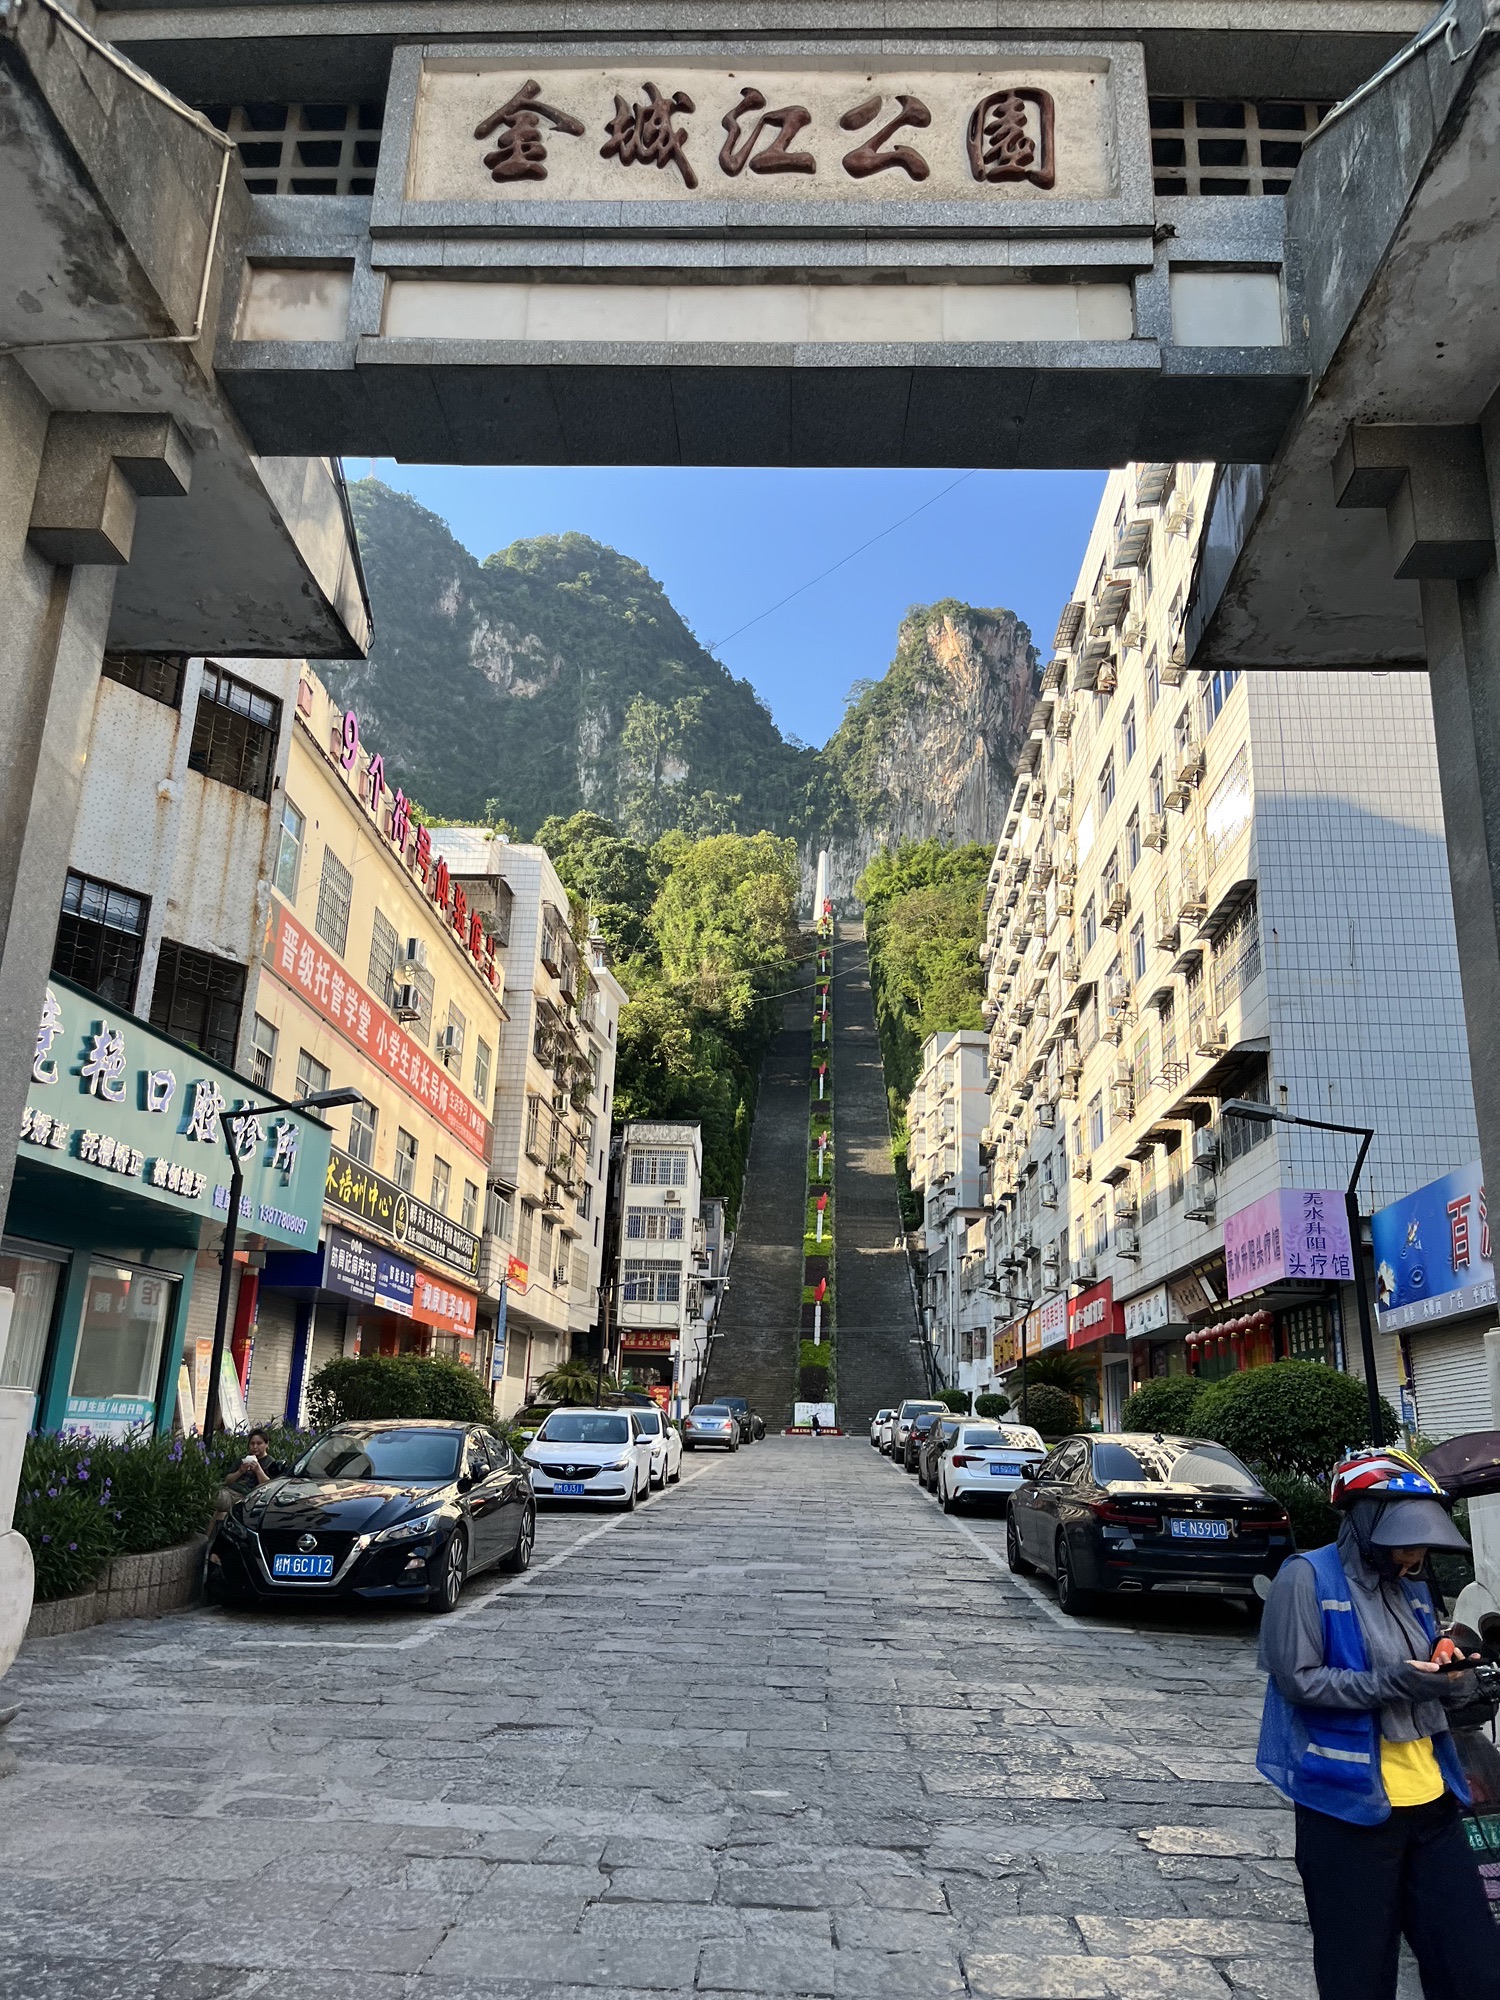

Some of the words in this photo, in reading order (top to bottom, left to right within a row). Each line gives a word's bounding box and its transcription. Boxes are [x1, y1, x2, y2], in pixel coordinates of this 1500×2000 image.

[281, 922, 372, 1044] 晋级托管学堂
[375, 1020, 449, 1116] 小学生成长导师
[1303, 1192, 1326, 1251] 无水升阳
[1227, 1226, 1280, 1281] 无水升阳头疗馆
[1289, 1253, 1350, 1277] 头疗馆
[1449, 1290, 1464, 1310] 广告
